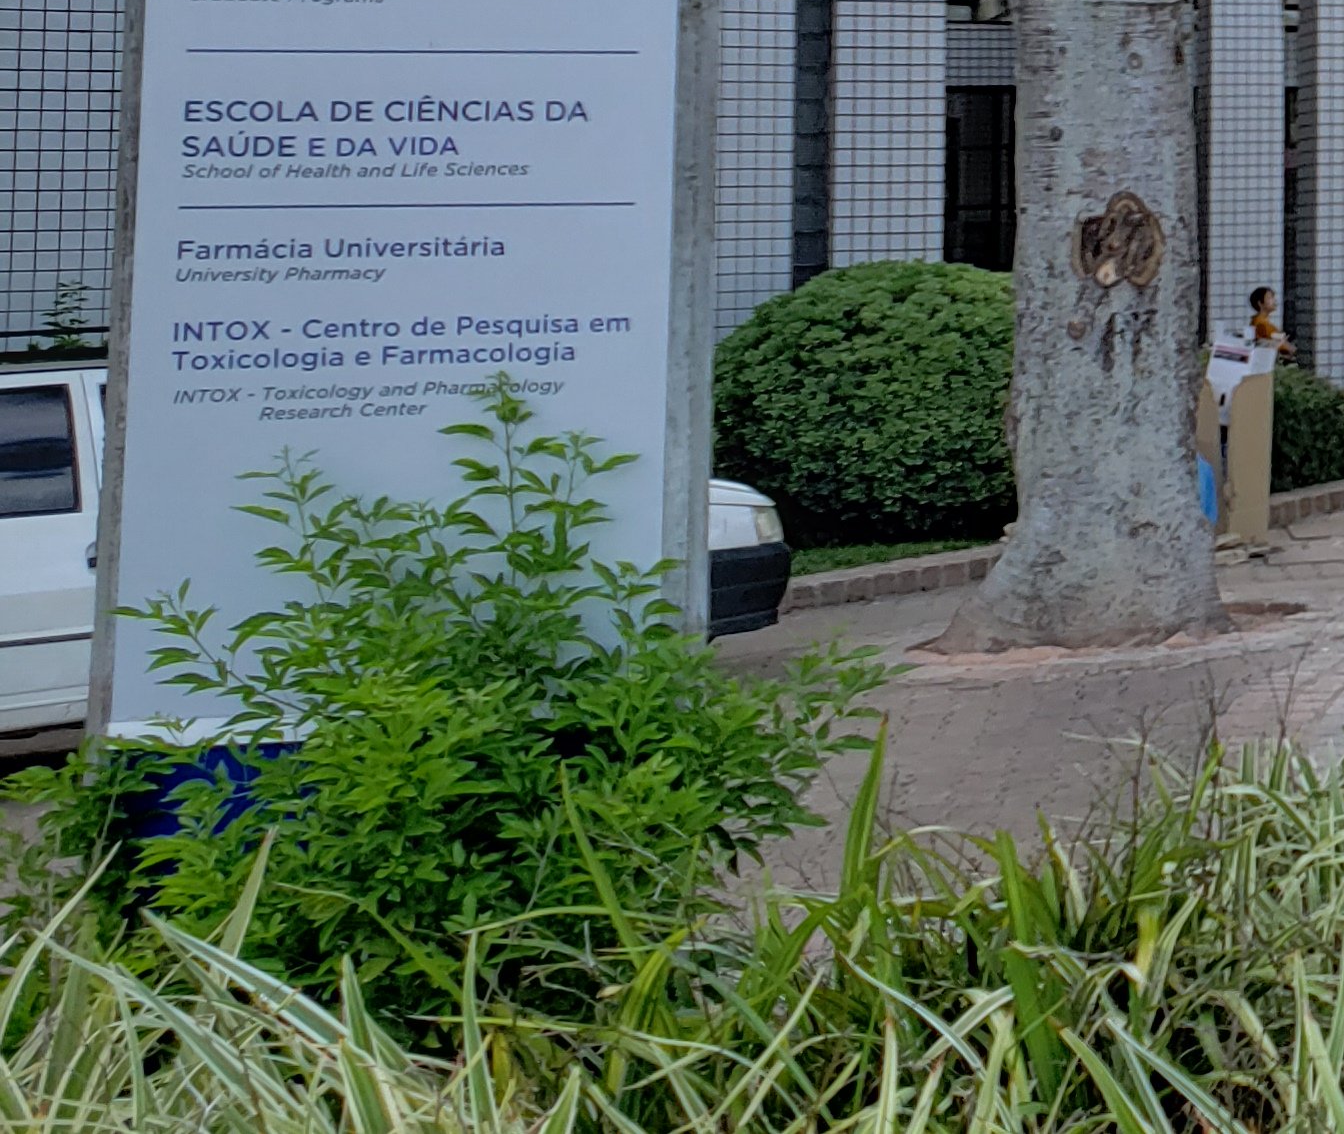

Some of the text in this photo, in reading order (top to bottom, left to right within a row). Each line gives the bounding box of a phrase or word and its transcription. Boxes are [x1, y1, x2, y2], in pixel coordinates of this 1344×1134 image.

[185, 95, 588, 122] ESCOLA DE CIÊNCIAS DA
[182, 131, 459, 157] SAÚDE E DA VIDA
[182, 162, 529, 178] School of Health and Life Sciences
[178, 237, 504, 259] Farmácia Universitária
[176, 267, 386, 284] University Pharmacy
[174, 321, 270, 342] INTOX
[302, 319, 400, 338] Centro
[411, 317, 445, 336] de
[457, 314, 578, 337] Pesquisa
[590, 318, 630, 332] em
[172, 342, 575, 371] Toxicologia e Farmacologia
[174, 388, 242, 404] INTOX
[263, 385, 374, 401] Toxicology
[379, 382, 418, 397] and
[259, 402, 427, 420] Research Center
